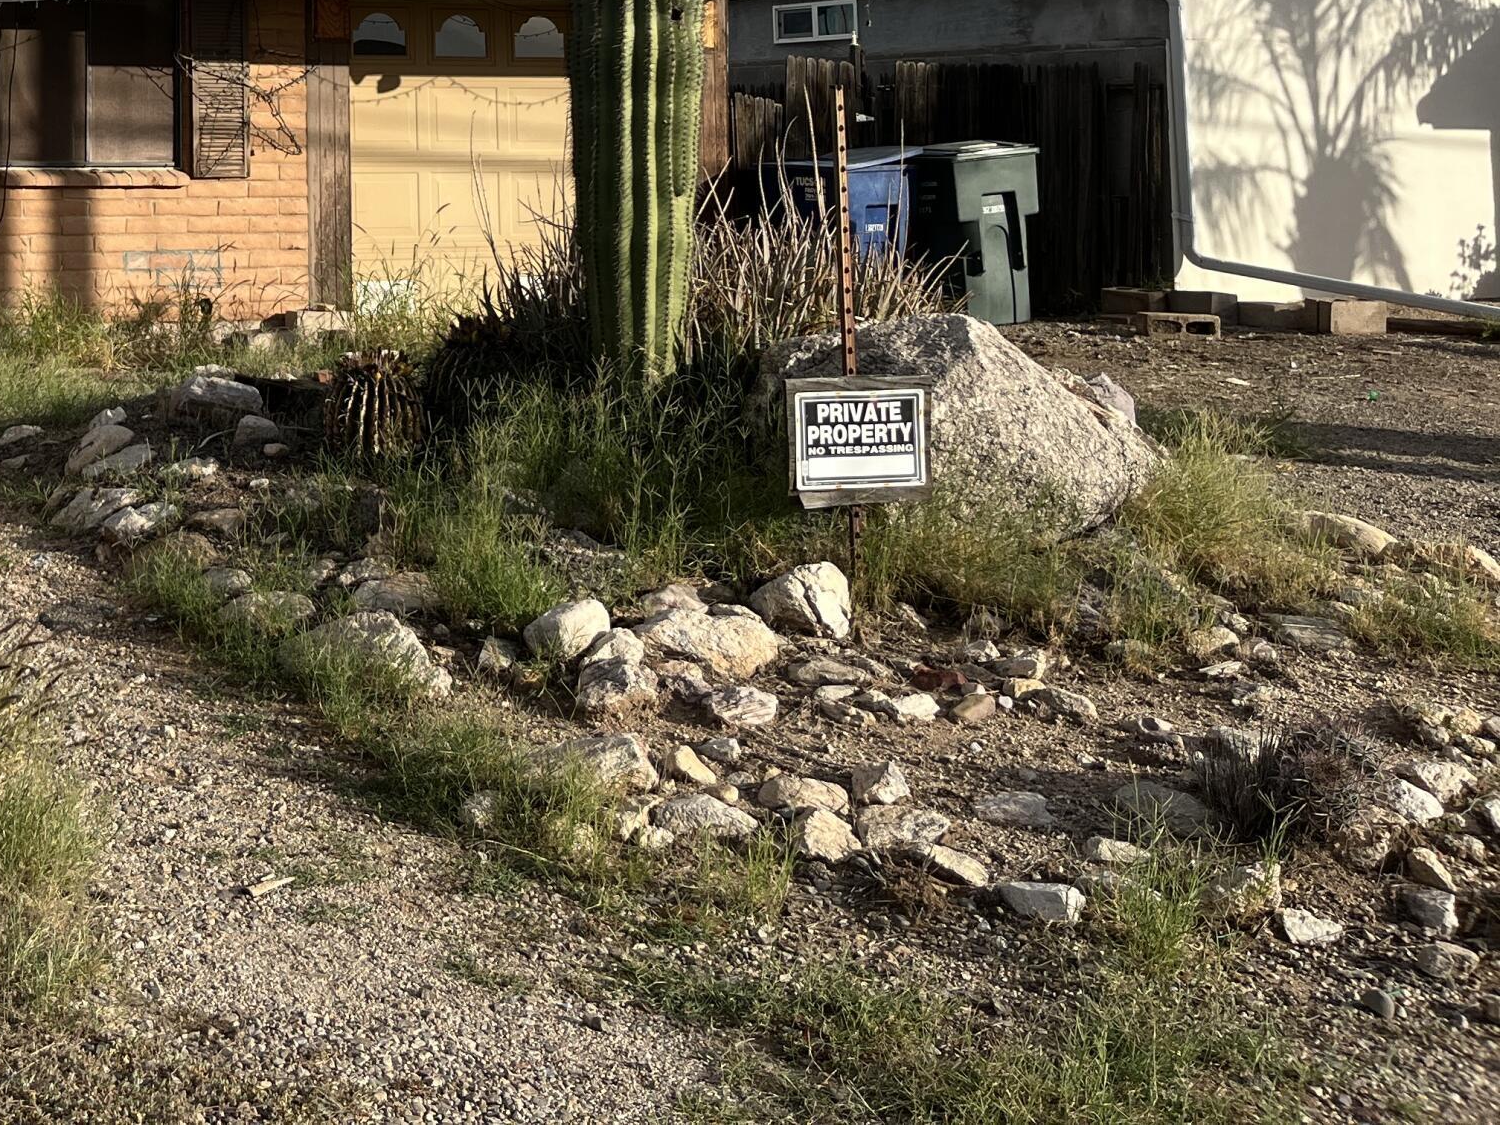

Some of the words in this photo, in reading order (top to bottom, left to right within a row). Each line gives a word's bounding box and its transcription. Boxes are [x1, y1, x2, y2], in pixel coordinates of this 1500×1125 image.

[817, 401, 902, 423] PRIVATE
[807, 422, 912, 445] PROPERTY
[808, 446, 826, 456] NO
[829, 443, 914, 455] TRESPASSING
